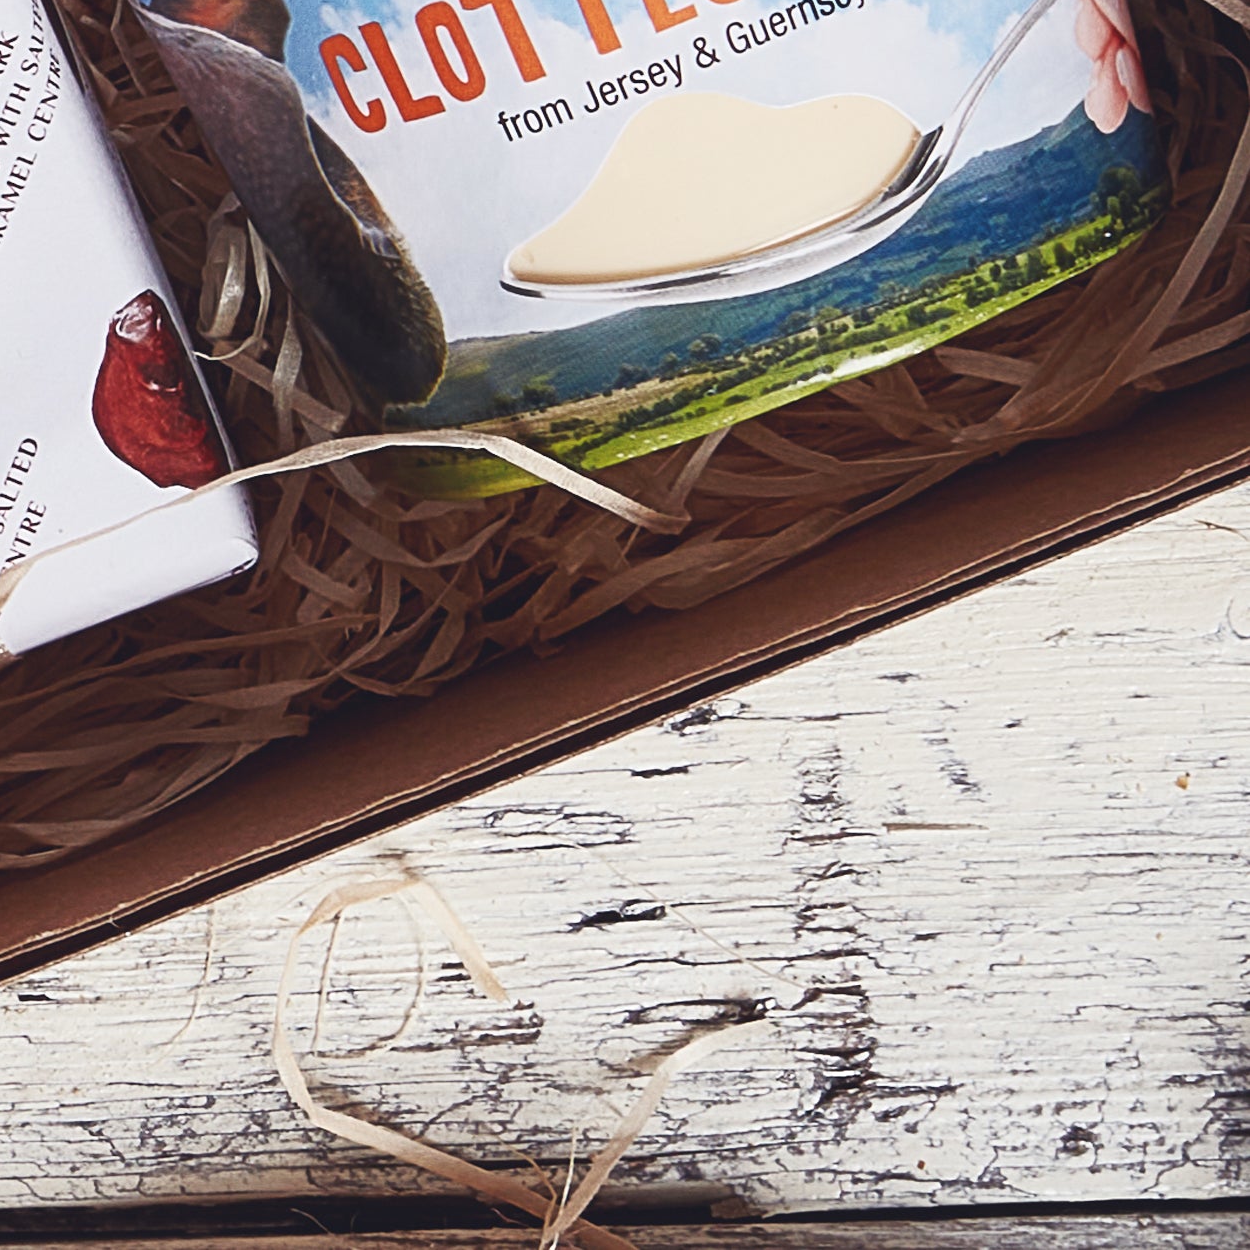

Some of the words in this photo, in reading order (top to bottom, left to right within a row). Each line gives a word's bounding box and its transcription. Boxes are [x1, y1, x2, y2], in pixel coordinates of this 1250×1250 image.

[498, 98, 573, 142] from
[582, 50, 684, 113] Jersey
[693, 37, 721, 68] &
[0, 501, 47, 572] NTRE
